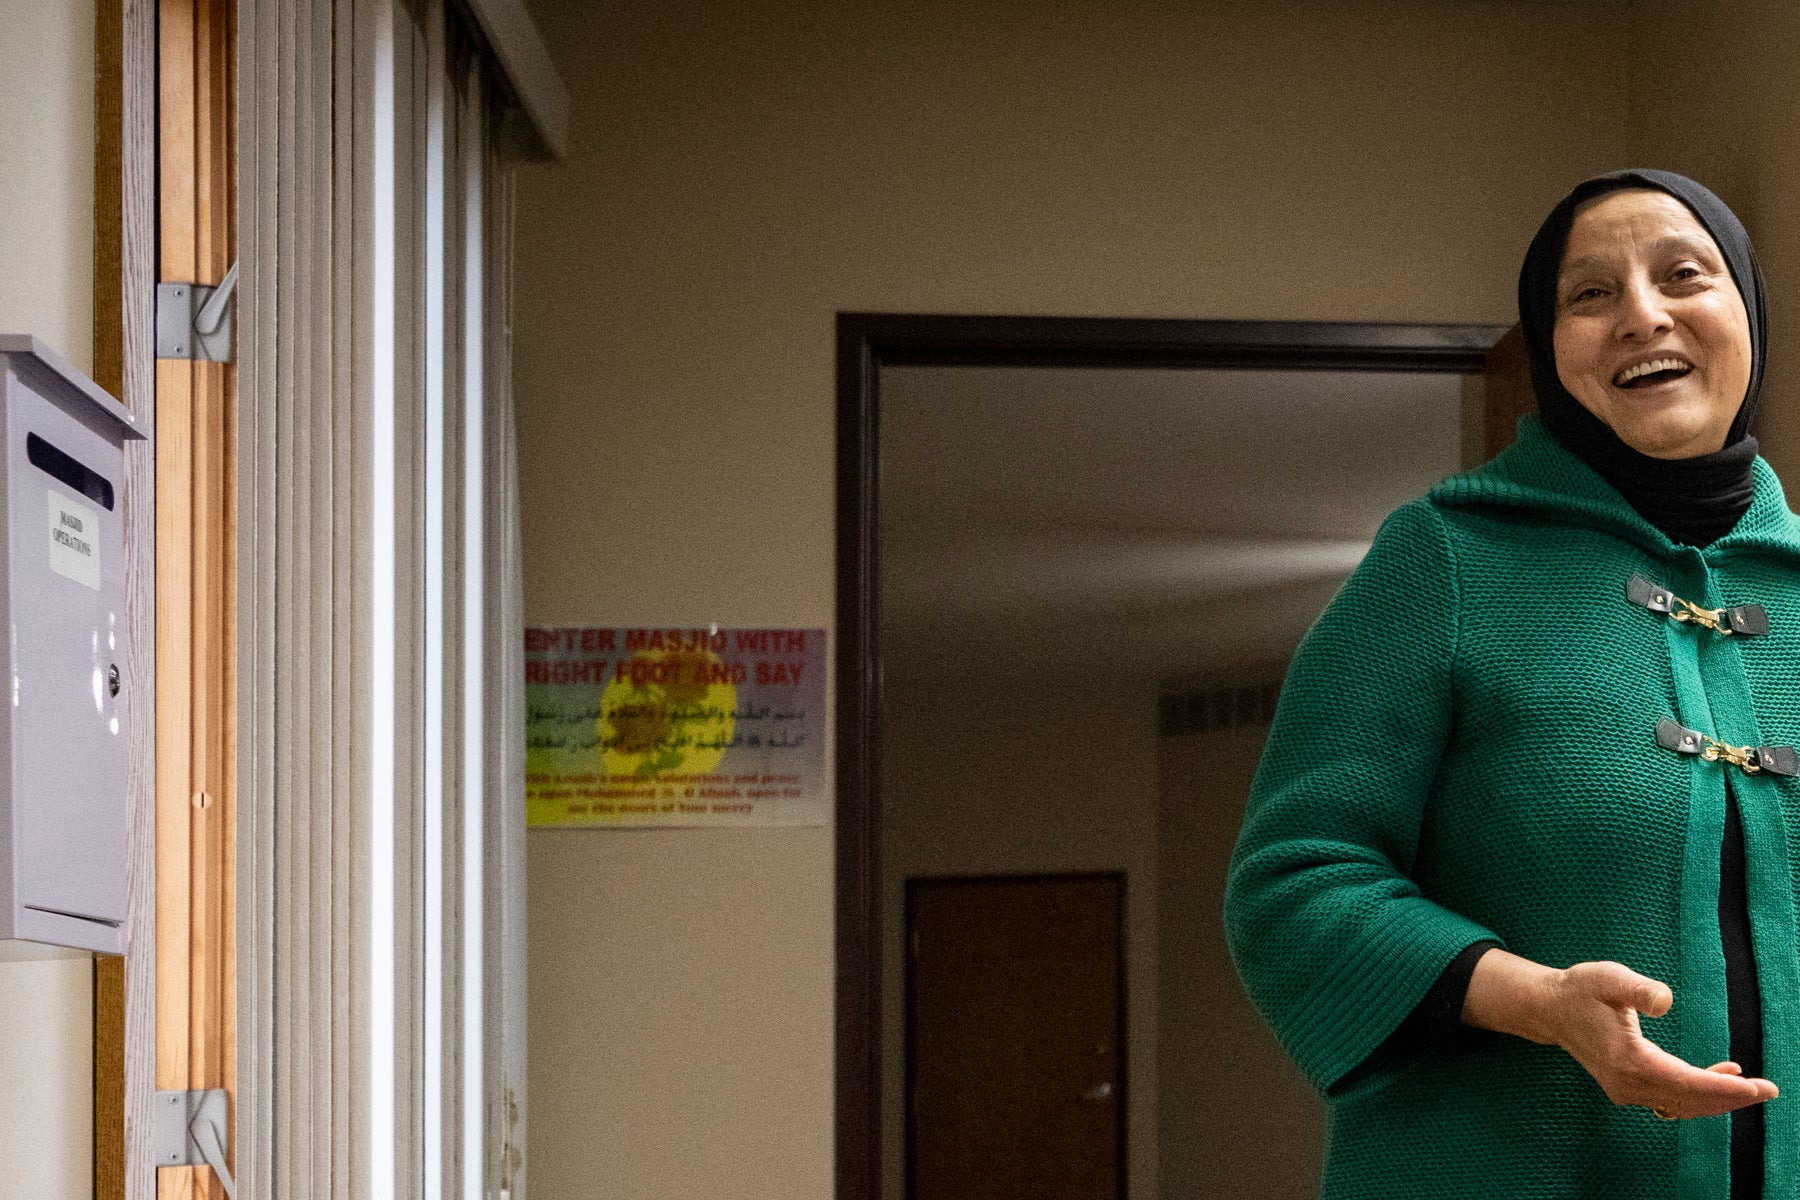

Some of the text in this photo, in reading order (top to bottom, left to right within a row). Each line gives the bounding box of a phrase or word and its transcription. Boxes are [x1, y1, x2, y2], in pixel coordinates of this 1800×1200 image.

[53, 528, 91, 557] OPERATIONS
[525, 628, 806, 653] ENTER MASJID WITH
[525, 661, 607, 685] RIGHT
[755, 662, 806, 685] SAY
